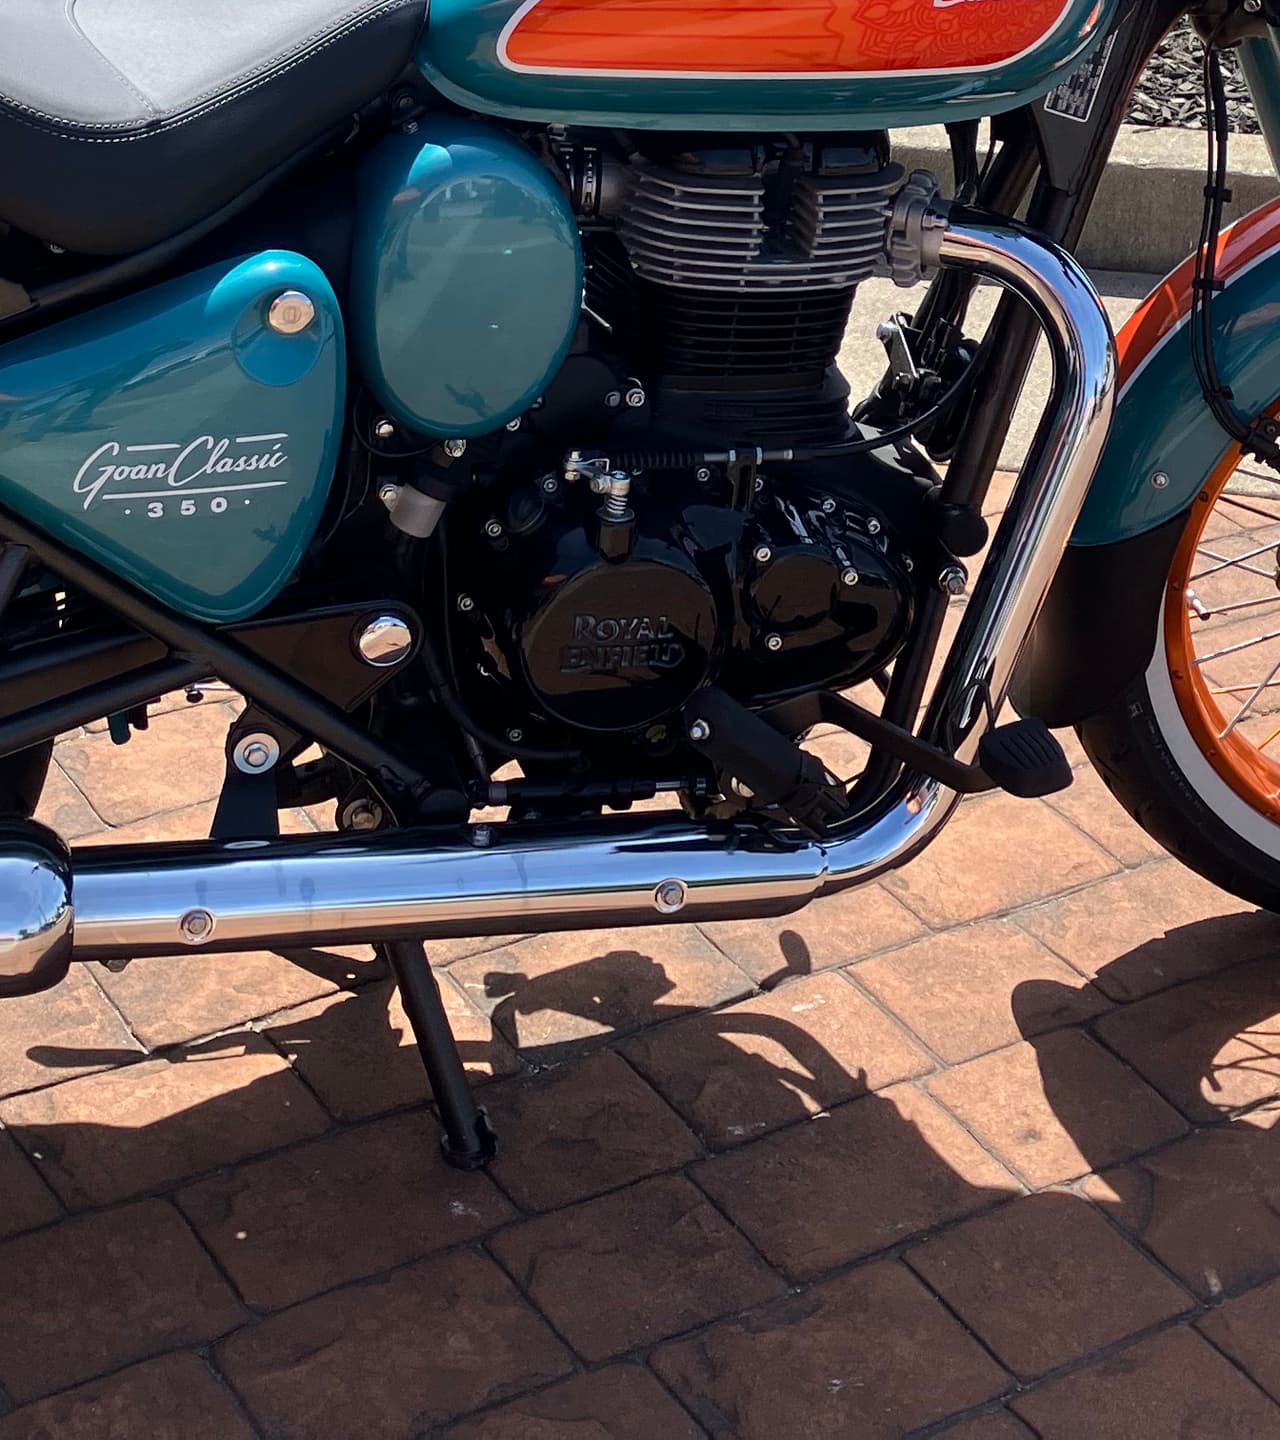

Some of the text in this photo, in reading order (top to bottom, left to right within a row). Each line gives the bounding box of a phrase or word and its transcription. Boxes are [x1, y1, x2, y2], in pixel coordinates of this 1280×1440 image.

[73, 435, 289, 510] Goan Classic
[574, 613, 675, 644] ROYAL
[560, 642, 686, 674] ENFIELD
